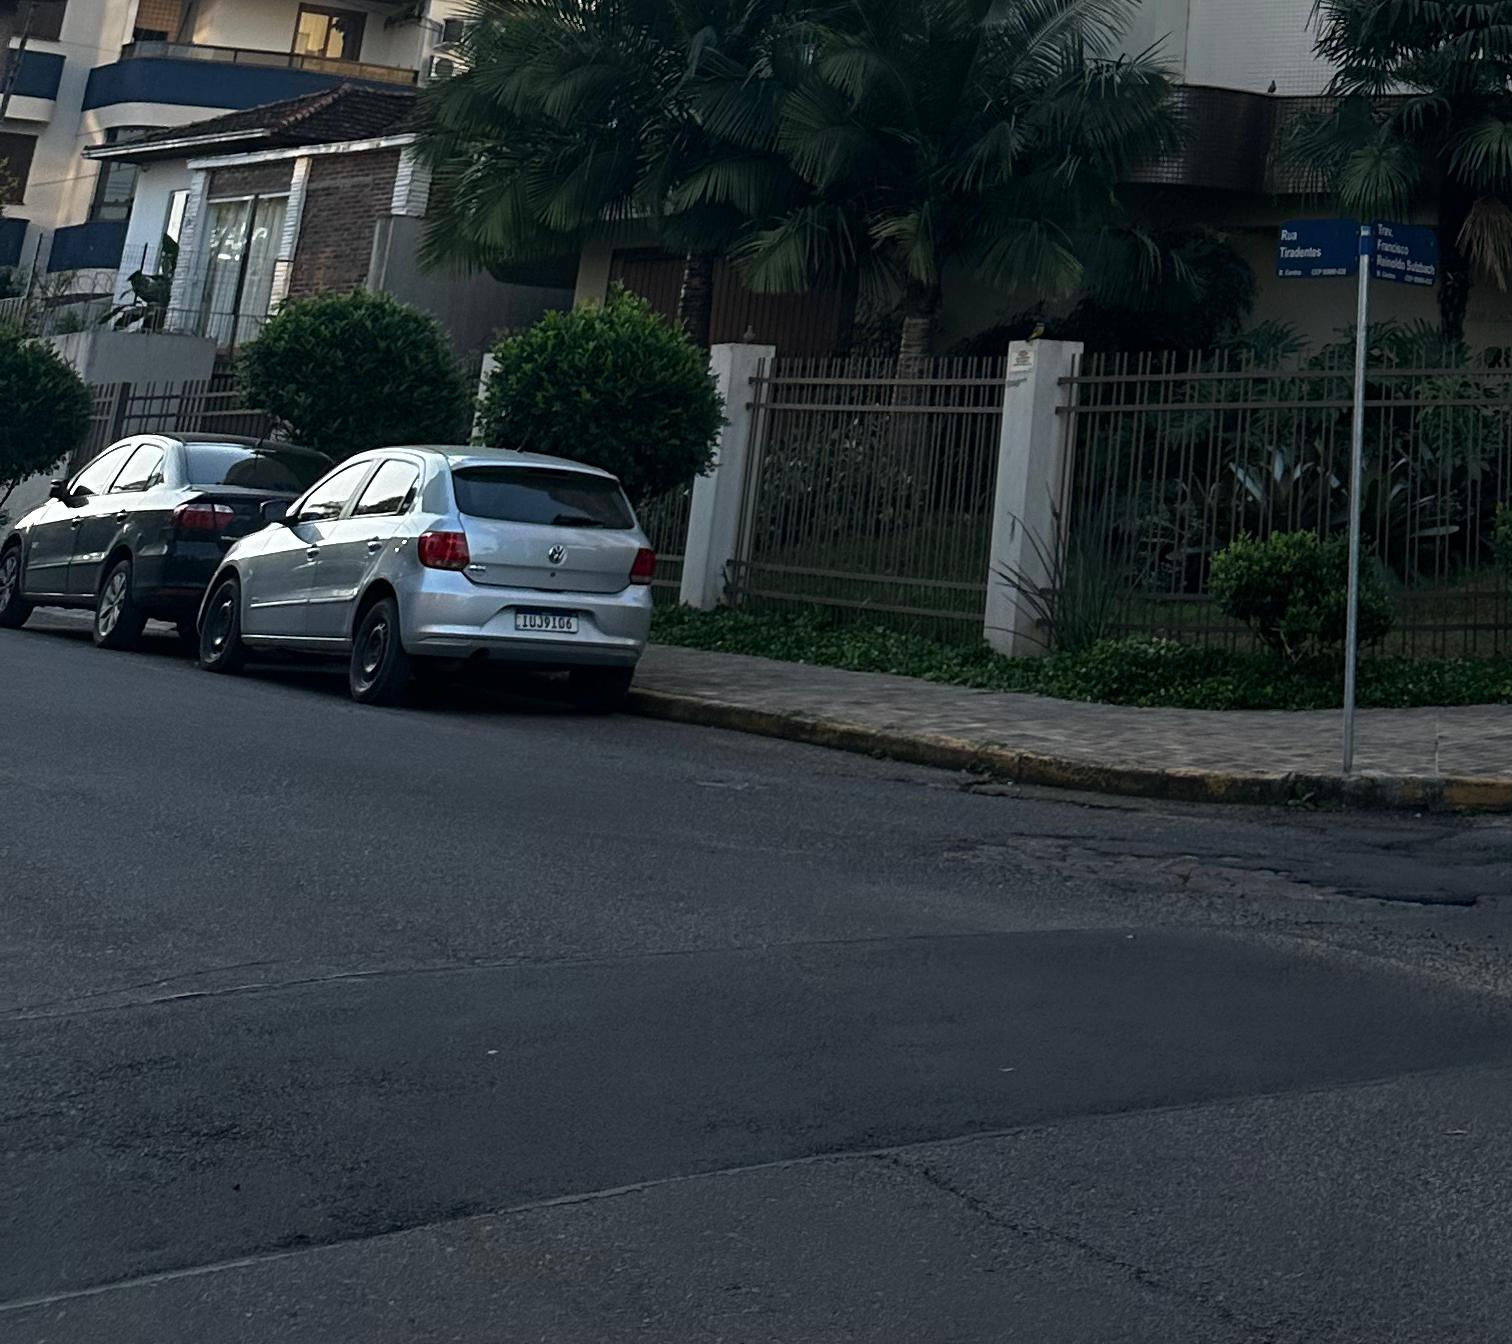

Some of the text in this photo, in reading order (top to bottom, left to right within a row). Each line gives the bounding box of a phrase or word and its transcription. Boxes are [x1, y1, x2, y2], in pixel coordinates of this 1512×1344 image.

[1280, 229, 1297, 240] Rua
[1377, 223, 1394, 238] Trav.
[1280, 246, 1322, 258] Tiradentes
[1377, 238, 1409, 255] Francisco
